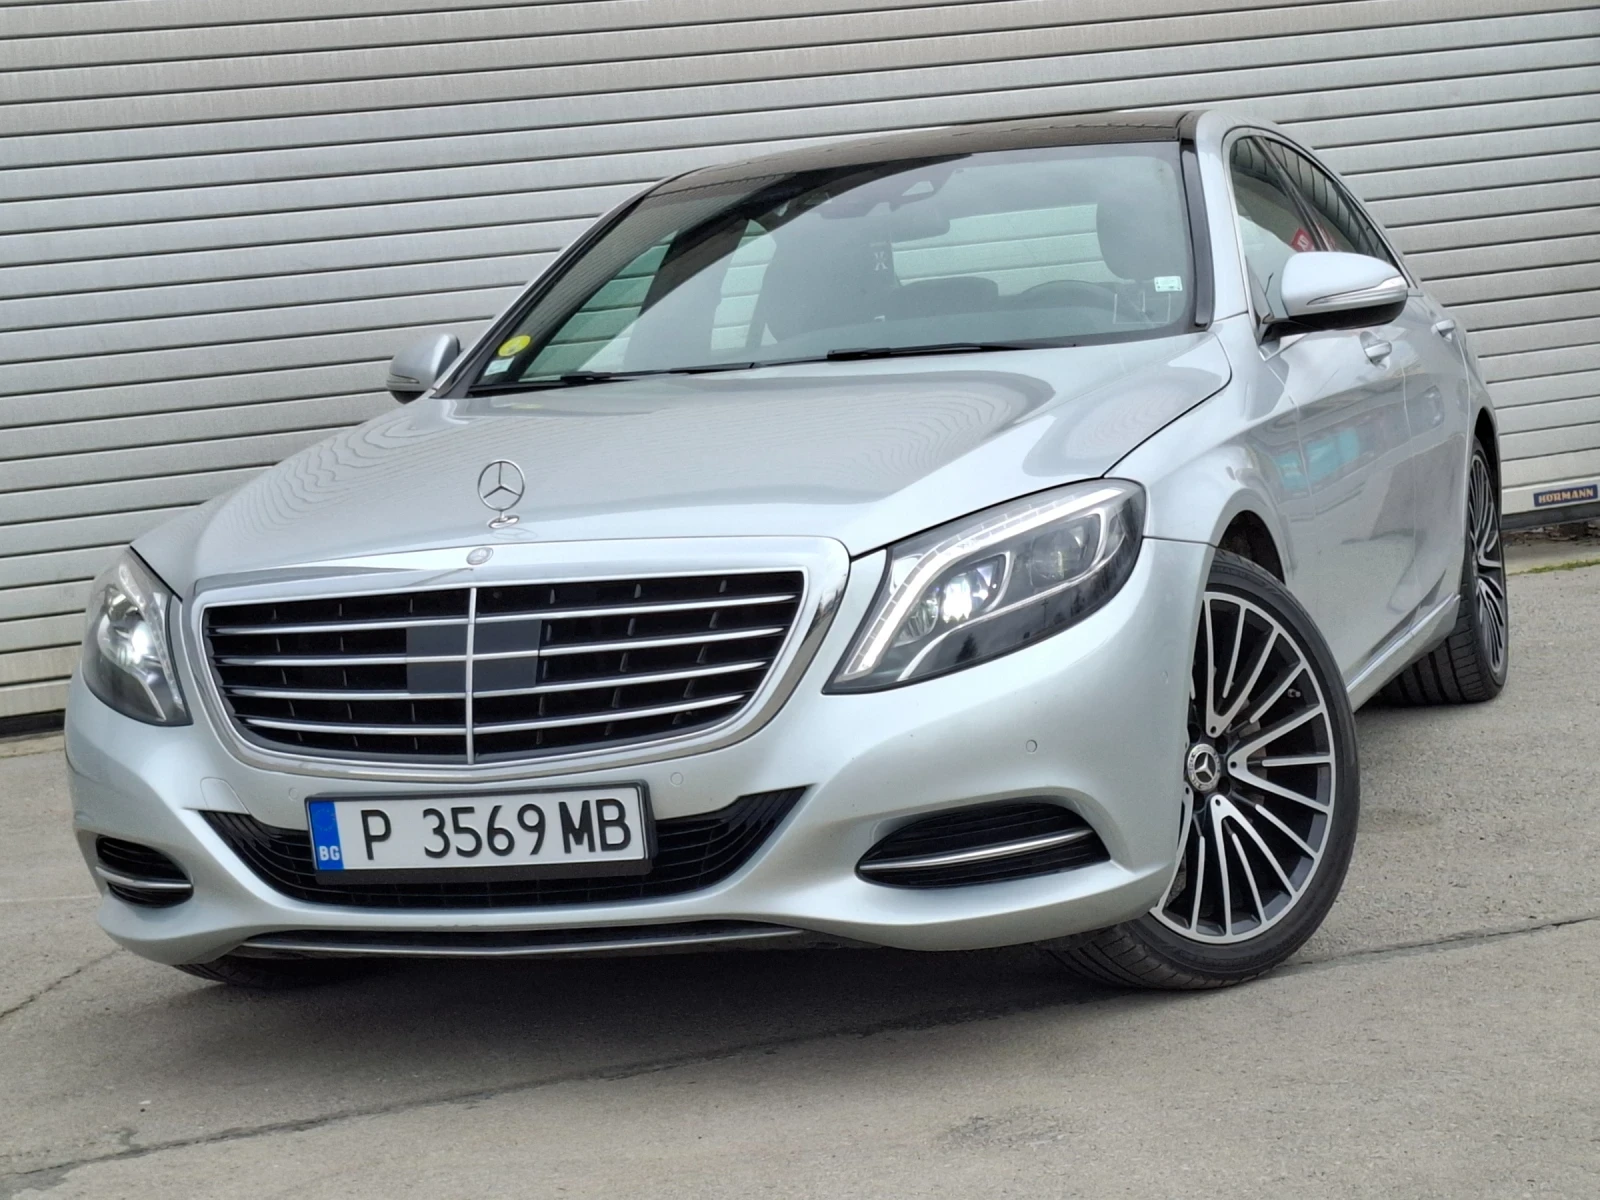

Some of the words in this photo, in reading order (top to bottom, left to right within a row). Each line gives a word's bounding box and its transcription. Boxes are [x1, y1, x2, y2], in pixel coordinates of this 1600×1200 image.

[360, 809, 392, 860] P
[422, 803, 547, 859] 3569
[558, 798, 632, 854] MB
[319, 845, 341, 861] BG
